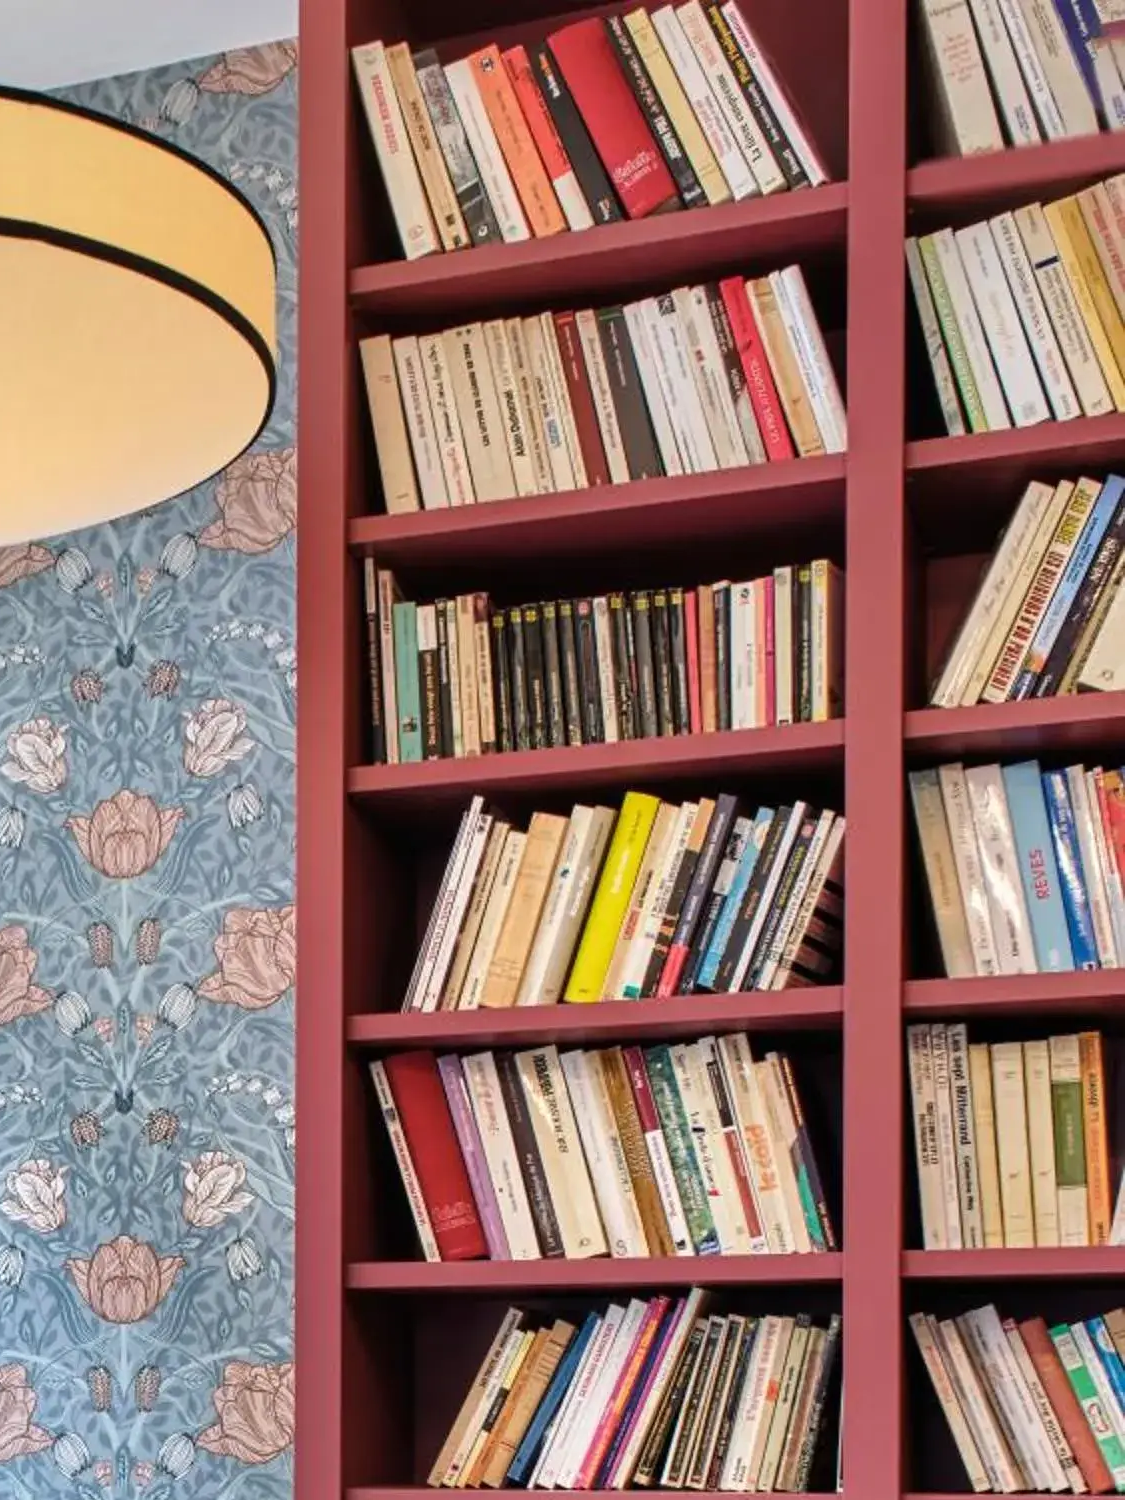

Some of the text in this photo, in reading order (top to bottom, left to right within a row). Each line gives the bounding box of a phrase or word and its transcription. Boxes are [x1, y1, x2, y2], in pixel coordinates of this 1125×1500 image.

[1026, 847, 1049, 899] RÊVES
[951, 1032, 971, 1144] Les sept Mitterrand
